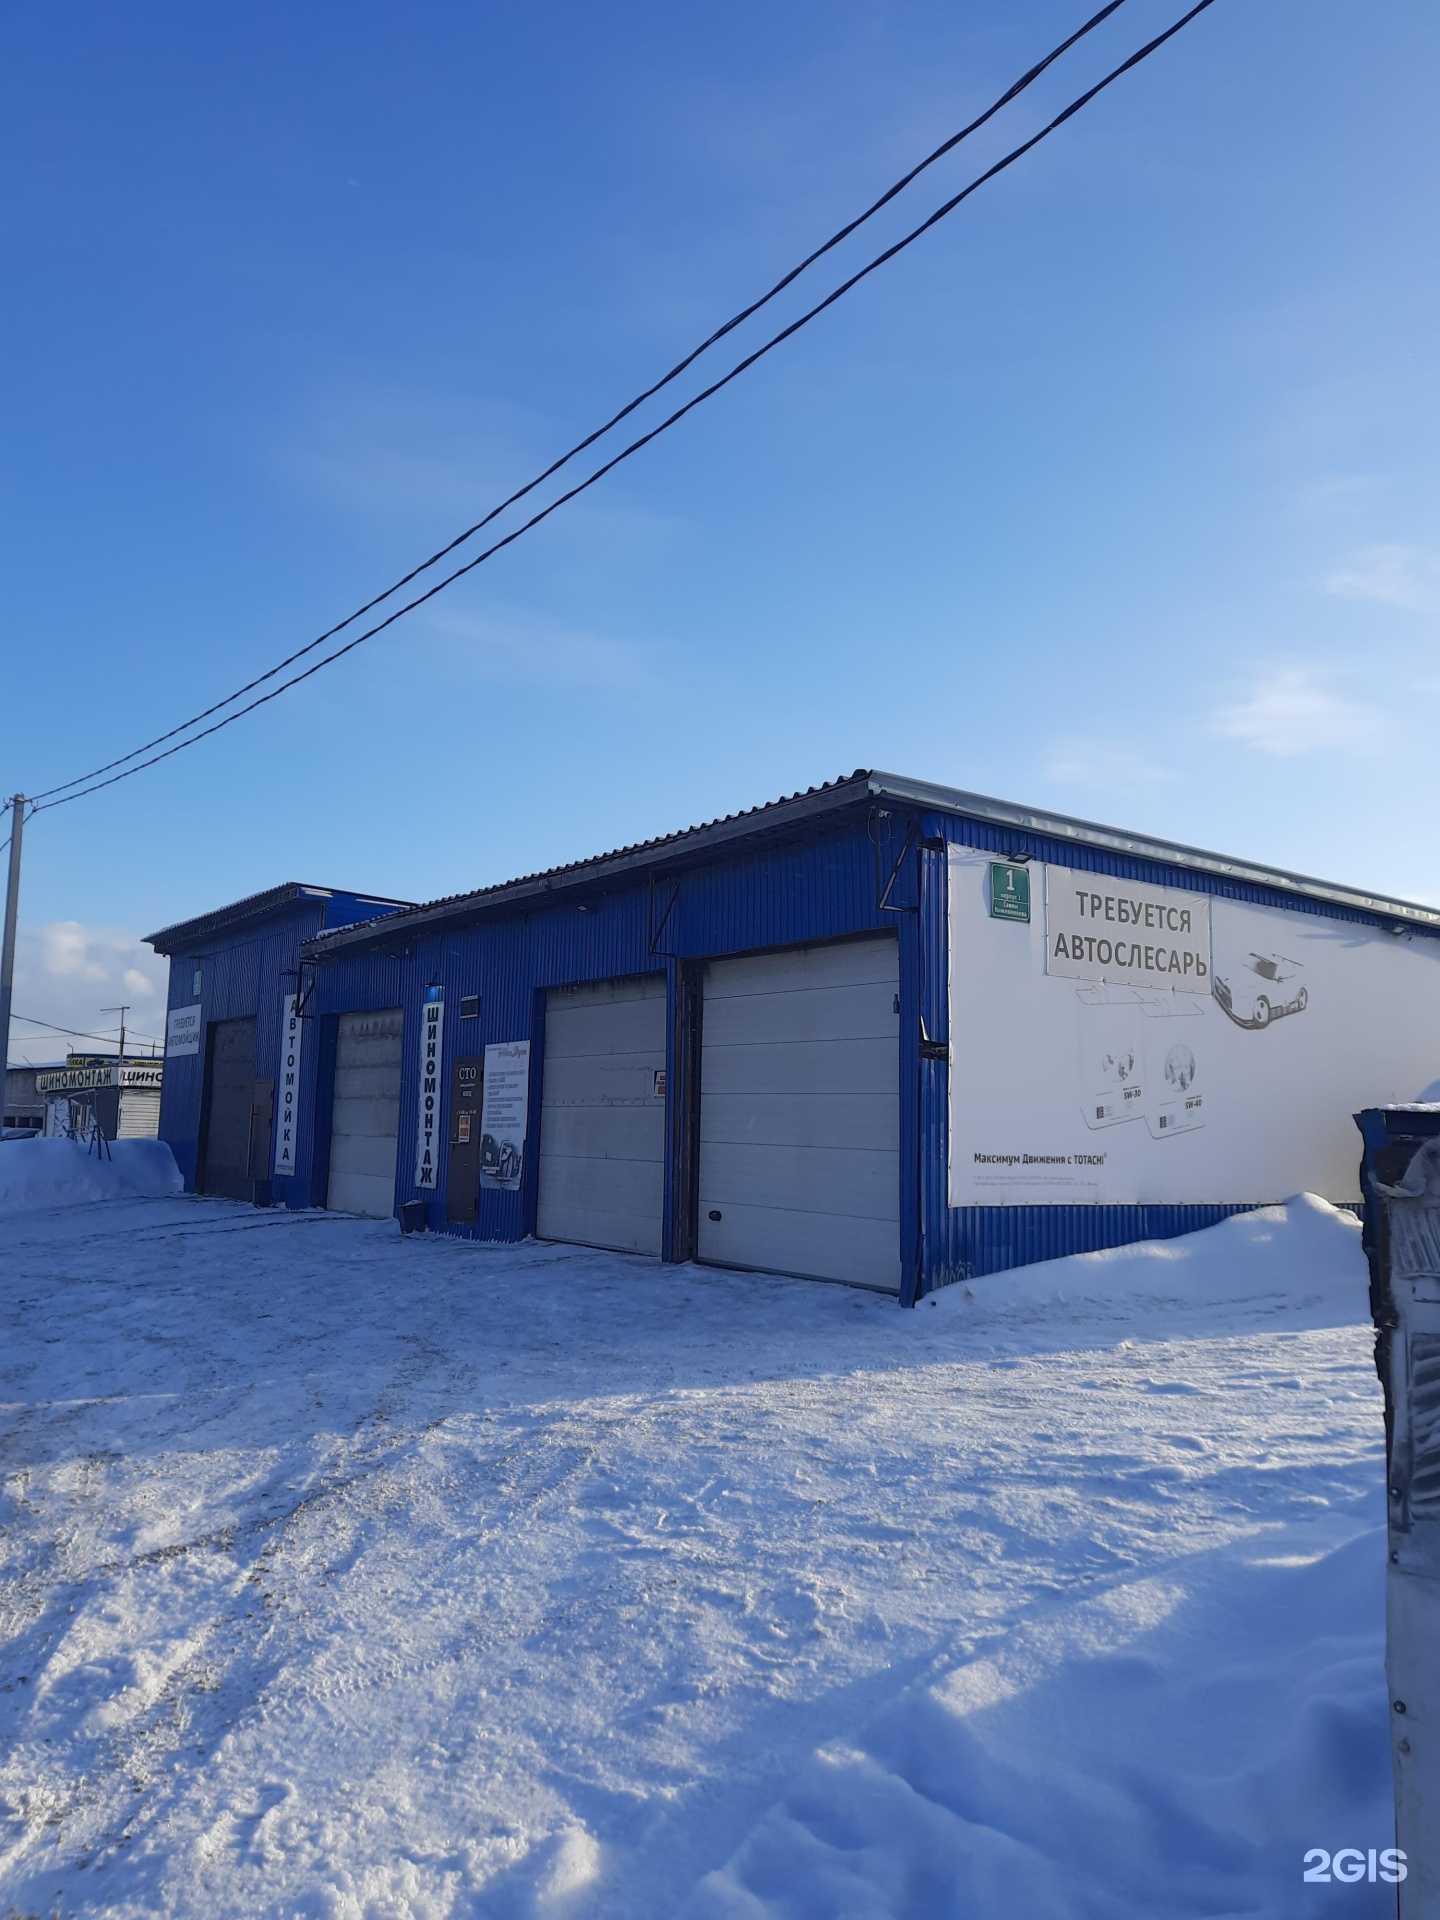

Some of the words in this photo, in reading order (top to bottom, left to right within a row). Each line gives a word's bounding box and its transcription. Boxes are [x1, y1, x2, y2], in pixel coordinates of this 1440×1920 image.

[1006, 869, 1015, 891] 1
[1075, 890, 1192, 934] ТРЕБУЕТСЯ
[1054, 932, 1208, 977] АВТОСЛЕСАРЬ
[40, 1068, 112, 1090] ШИНОМОНТАЖ
[281, 1001, 298, 1161] АВТОМОЙКА
[458, 1067, 477, 1080] СТО
[420, 1006, 440, 1184] ШИНОМОНТАЖ
[974, 1152, 1020, 1167] Максимум
[1022, 1153, 1066, 1166] Движения
